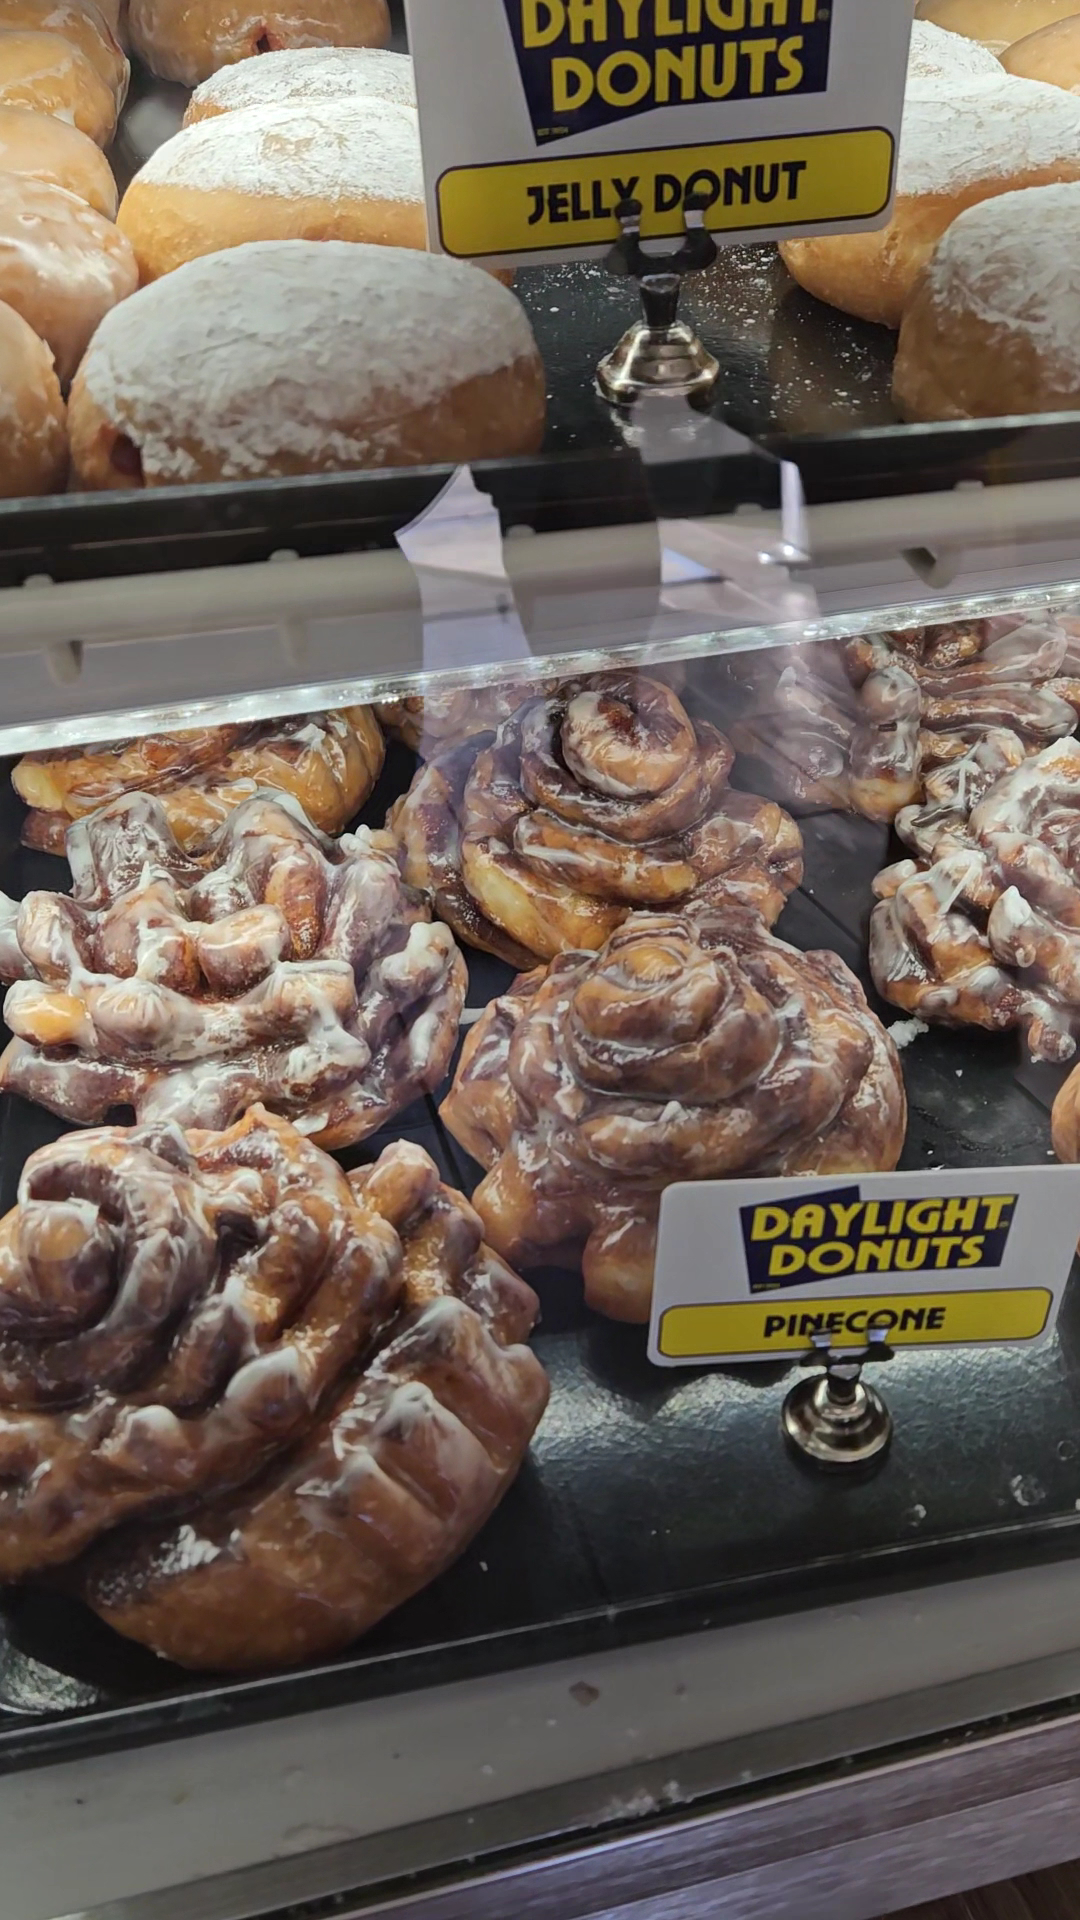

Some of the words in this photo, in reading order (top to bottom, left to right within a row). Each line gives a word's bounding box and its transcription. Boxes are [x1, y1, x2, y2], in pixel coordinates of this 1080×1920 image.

[551, 35, 804, 112] DONUTS
[654, 160, 807, 213] DONUT
[751, 1196, 1014, 1241] DAYLIGHT
[768, 1236, 985, 1277] DONUTS
[763, 1307, 946, 1338] PINECONE
